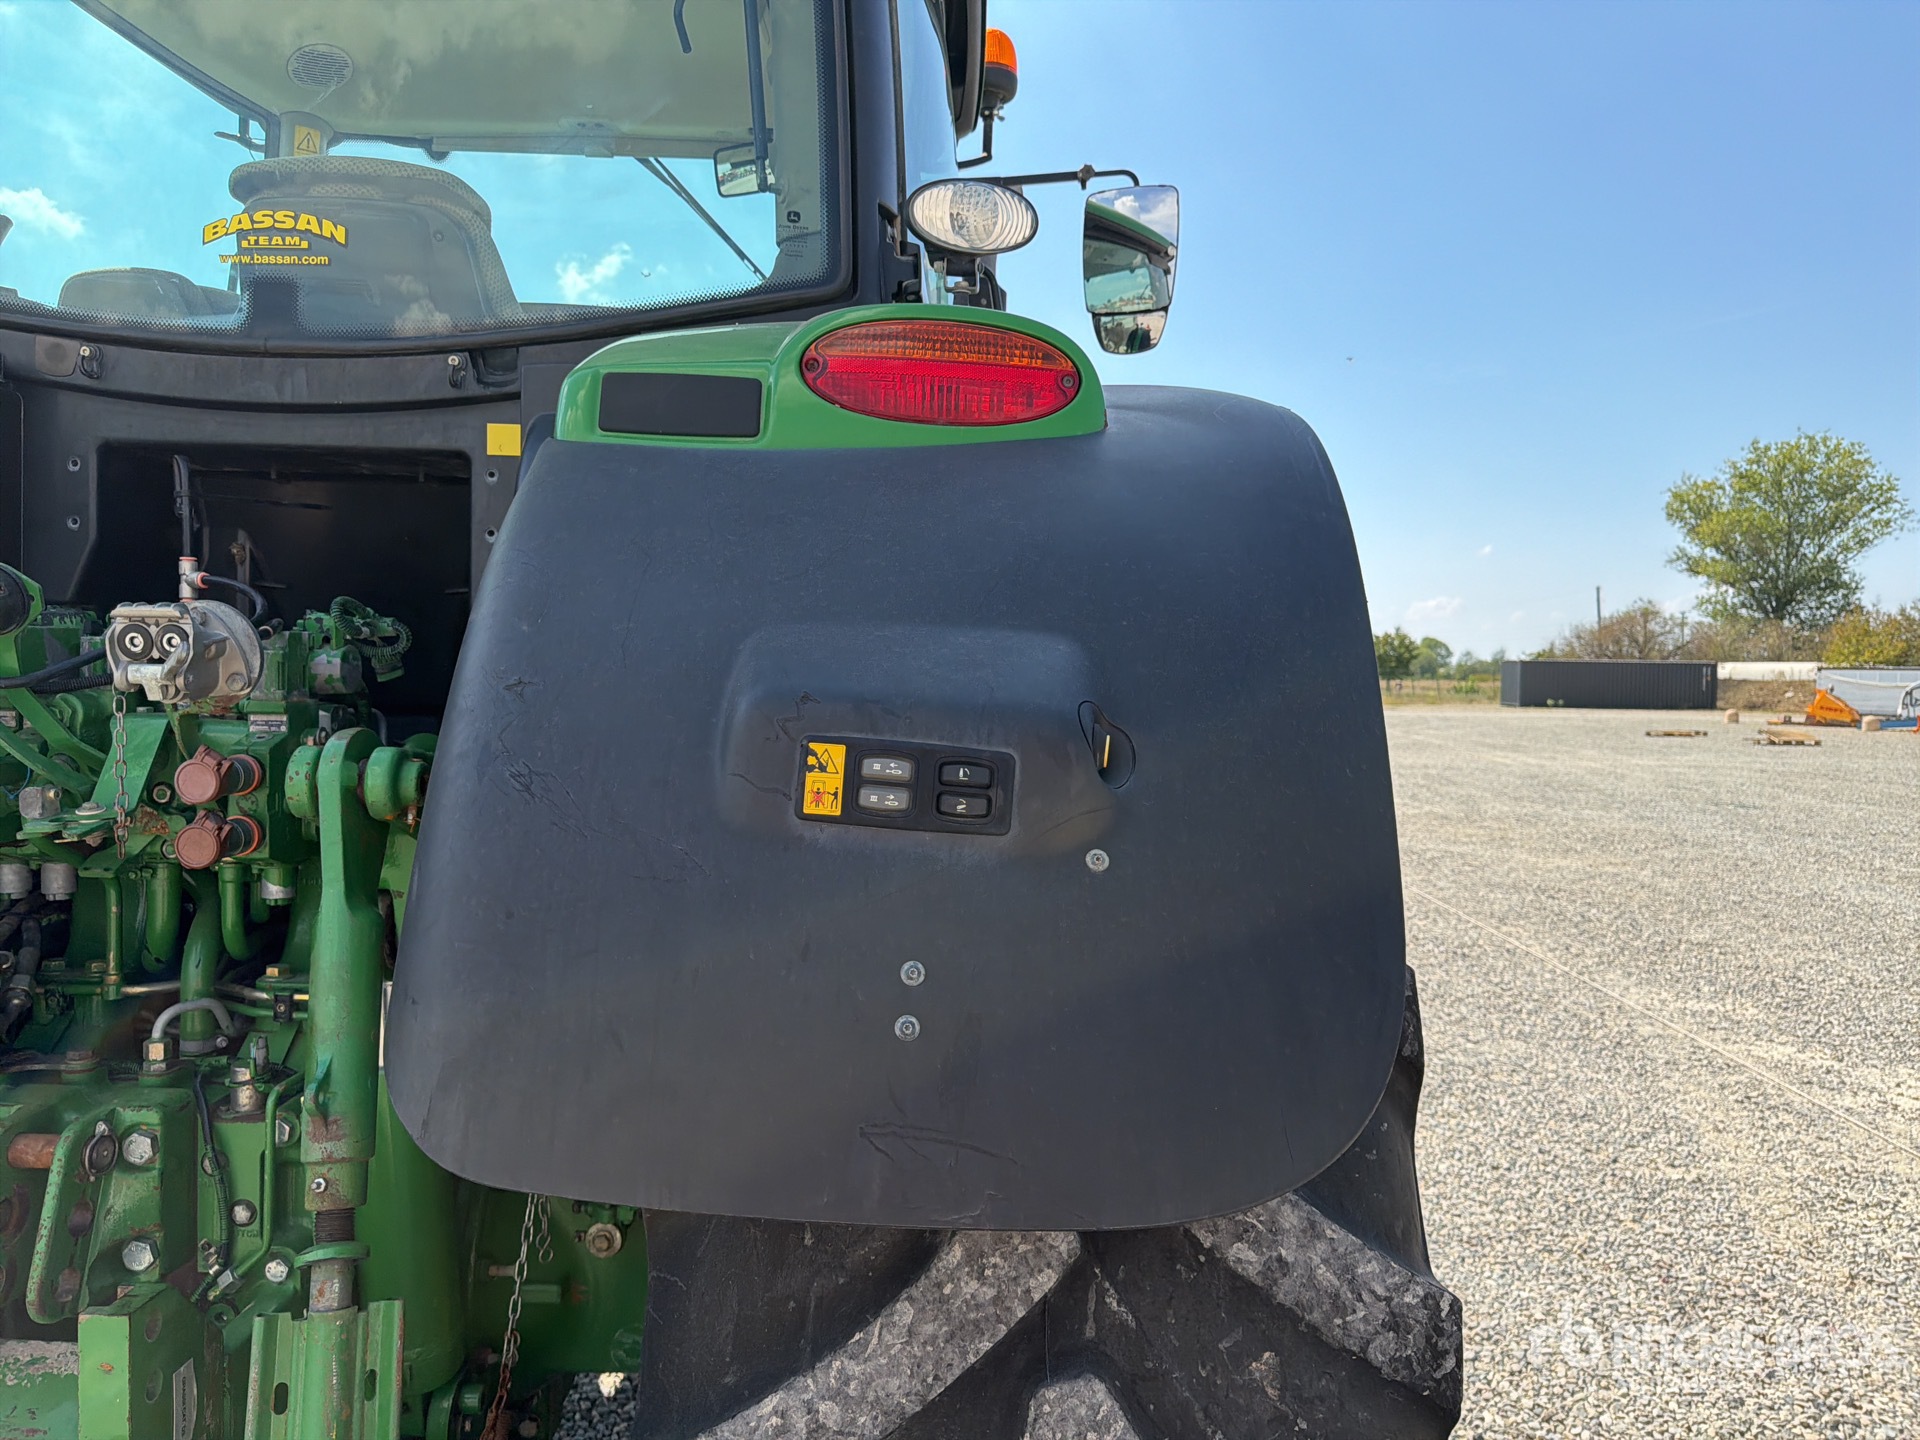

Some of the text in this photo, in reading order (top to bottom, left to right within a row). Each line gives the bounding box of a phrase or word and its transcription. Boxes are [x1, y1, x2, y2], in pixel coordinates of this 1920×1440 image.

[204, 210, 346, 245] BASSAN
[247, 236, 301, 246] TEAM
[219, 254, 329, 265] www.bassan.com
